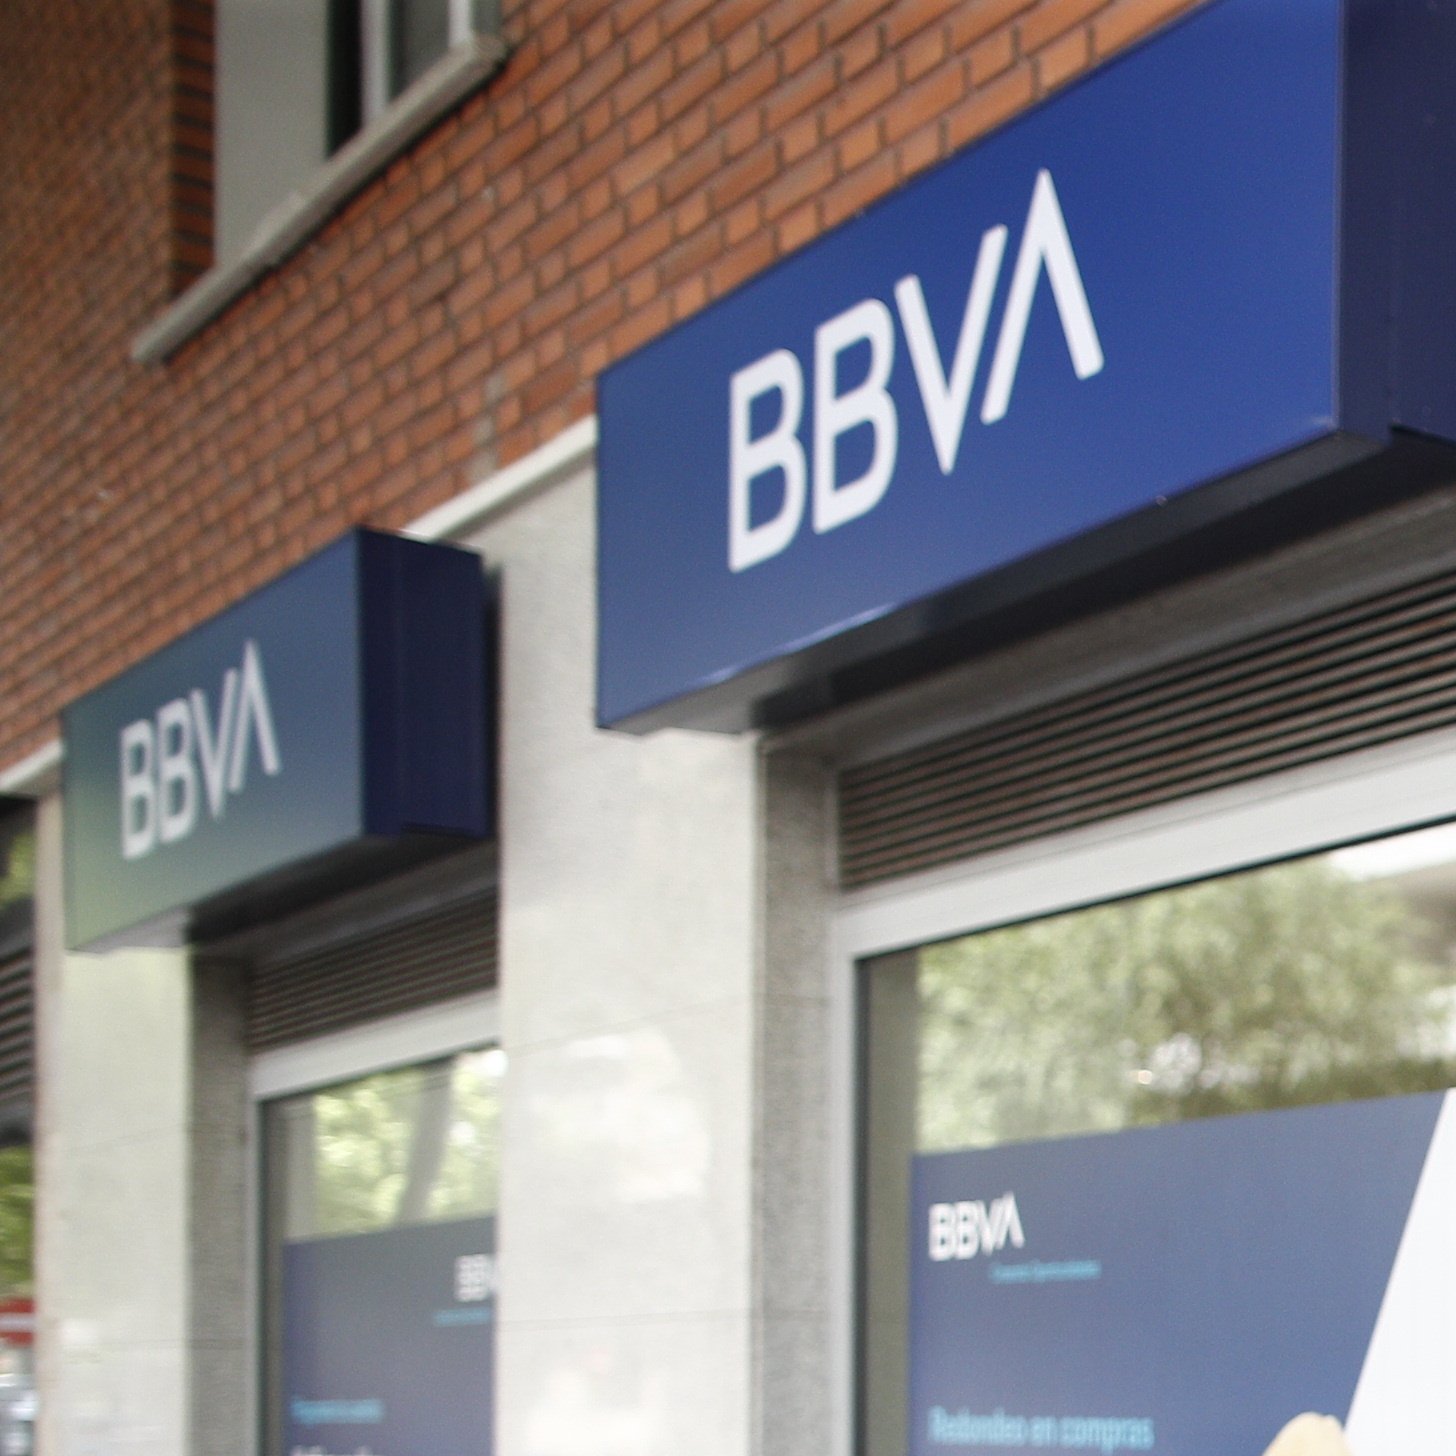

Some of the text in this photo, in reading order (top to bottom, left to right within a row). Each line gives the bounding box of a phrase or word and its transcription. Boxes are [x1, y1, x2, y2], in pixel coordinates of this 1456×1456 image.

[728, 167, 1104, 573] BBVA
[120, 640, 281, 860] BBVA
[929, 1191, 1025, 1261] BBVA
[1059, 1416, 1154, 1456] compras
